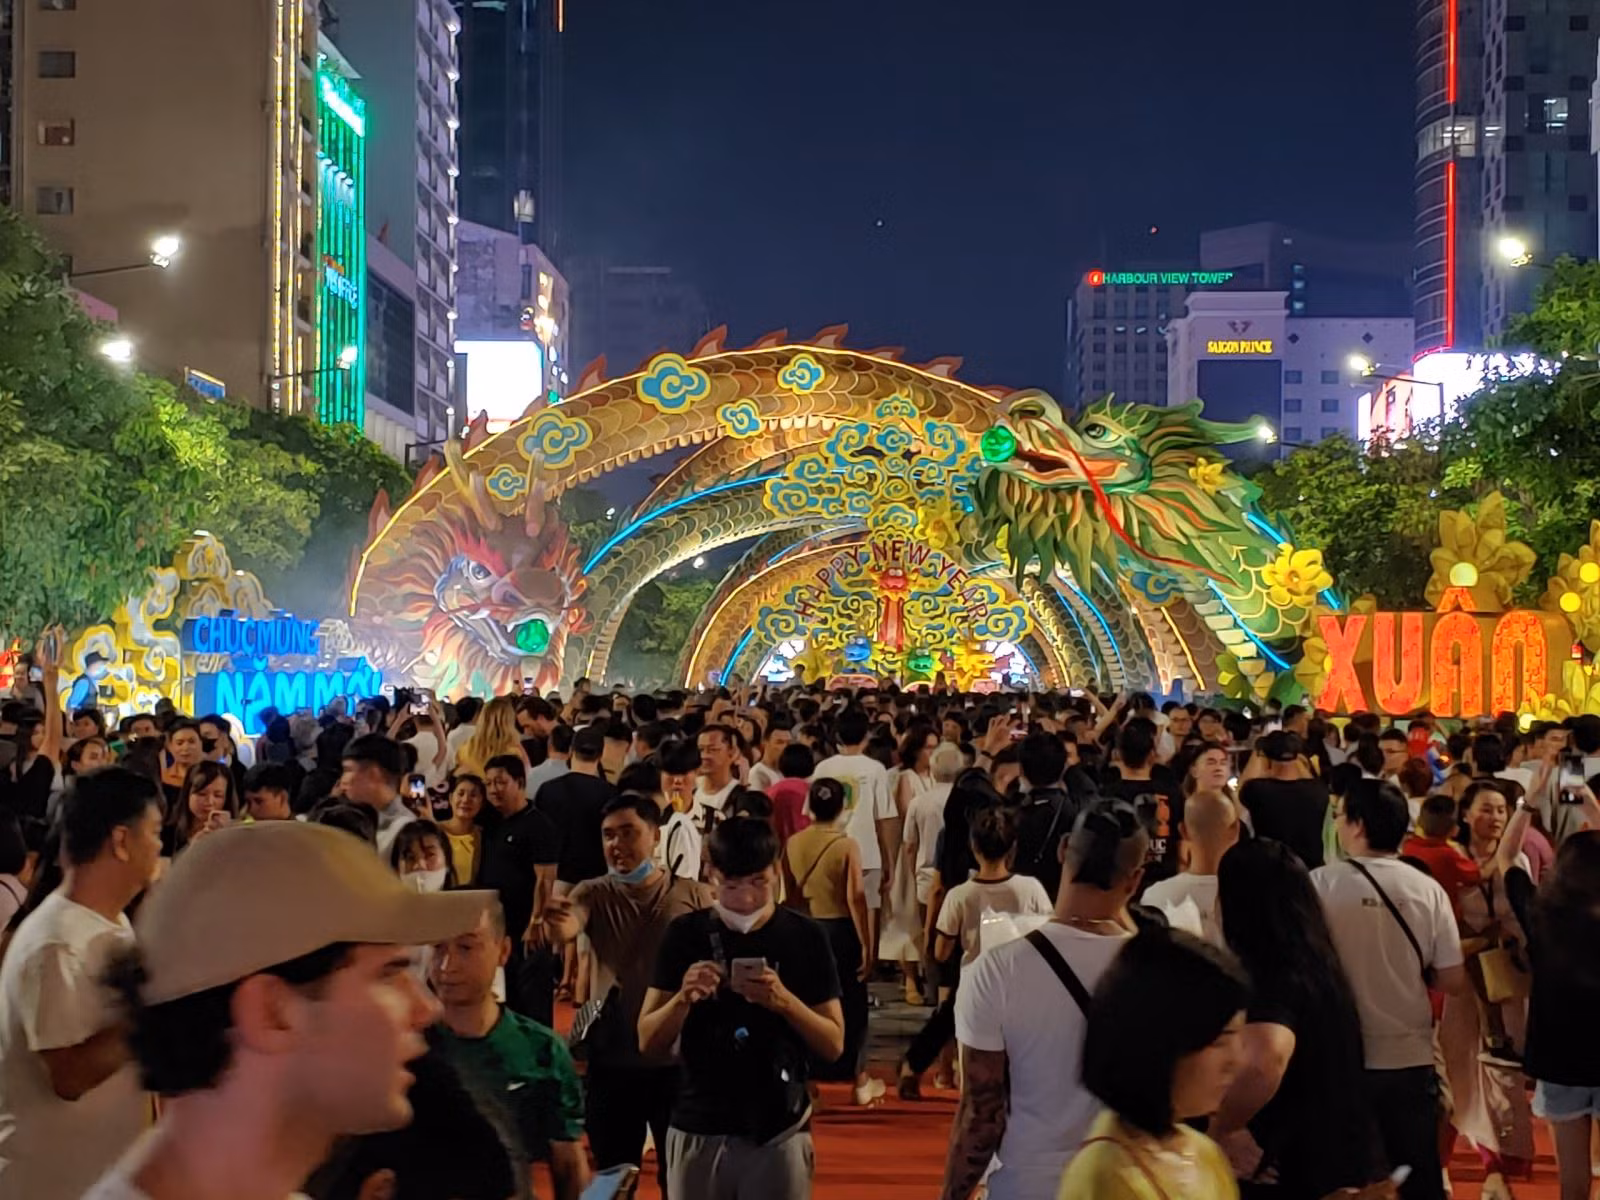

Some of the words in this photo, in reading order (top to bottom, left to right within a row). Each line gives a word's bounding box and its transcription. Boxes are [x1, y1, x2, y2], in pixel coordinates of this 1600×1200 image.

[1102, 272, 1159, 284] HARBOUR
[1160, 272, 1190, 284] VIEW
[1207, 340, 1239, 353] SAIGON
[793, 546, 862, 618] HAPPY
[871, 539, 932, 566] NEW
[936, 555, 991, 622] YEAR
[1315, 586, 1548, 718] XUÂN
[216, 656, 307, 734] NĂM
